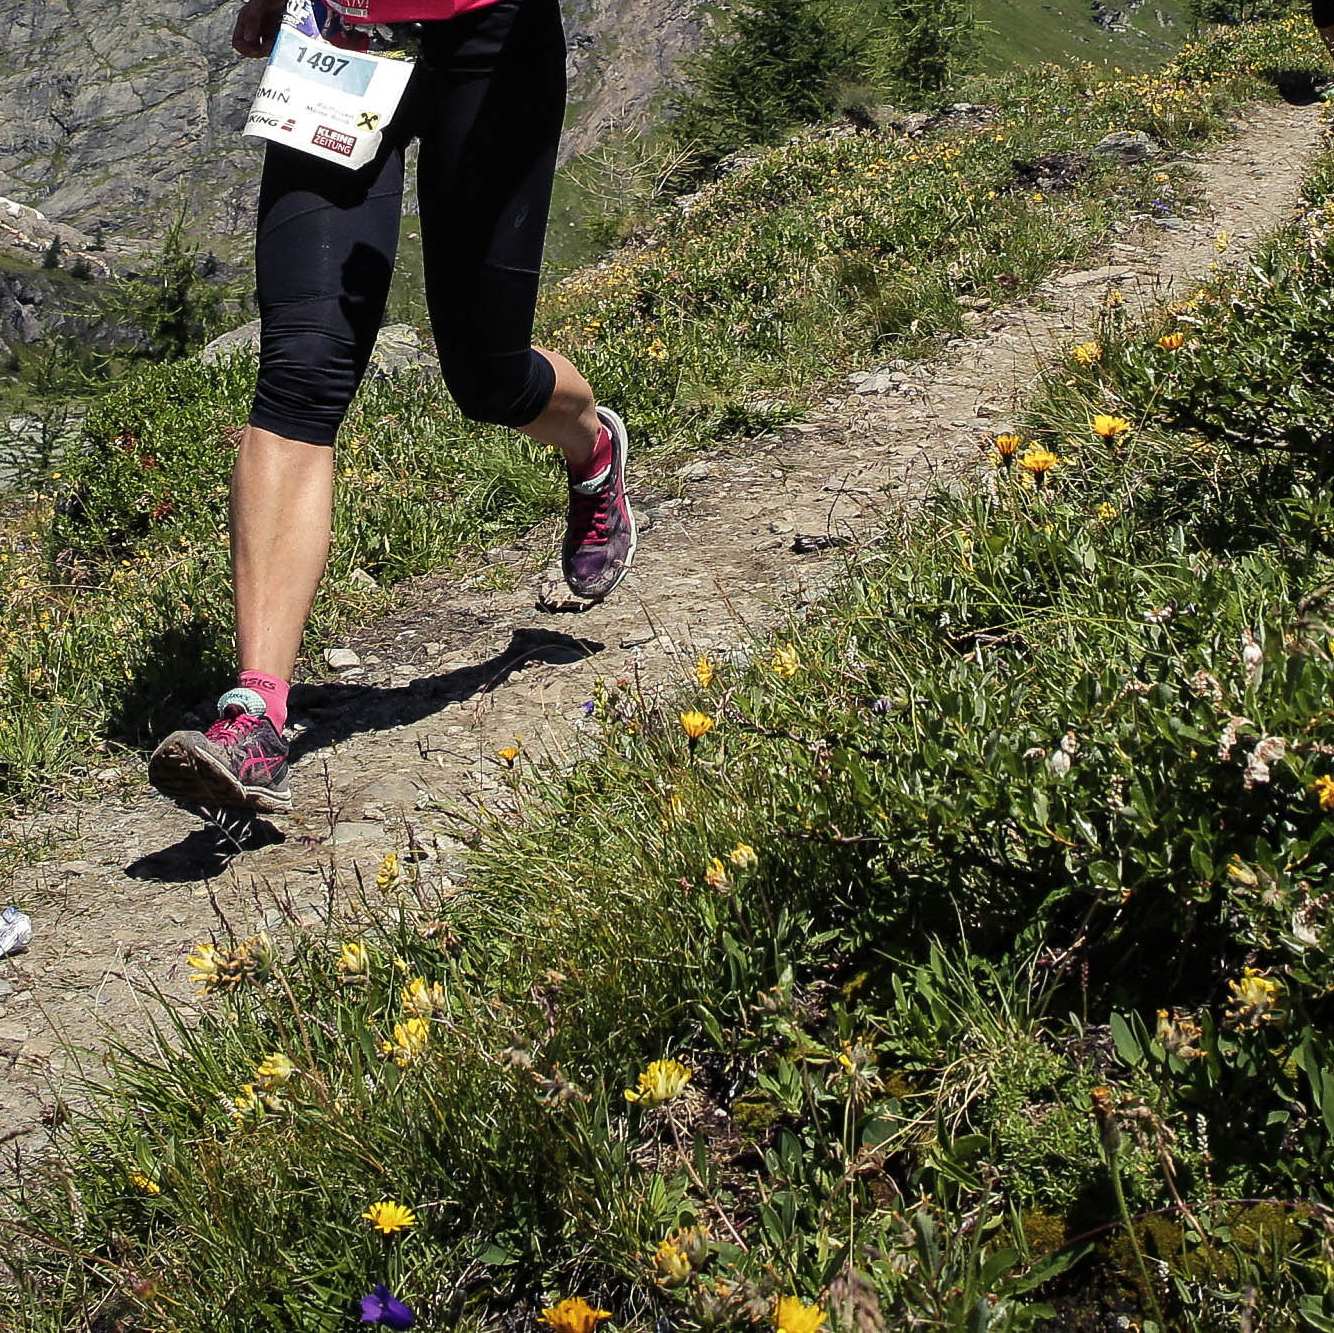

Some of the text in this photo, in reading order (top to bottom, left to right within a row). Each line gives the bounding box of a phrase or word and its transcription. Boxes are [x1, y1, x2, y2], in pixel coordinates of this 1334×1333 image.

[296, 46, 350, 77] 1497
[313, 134, 352, 155] ZEITUNG
[316, 126, 355, 146] KLEINE
